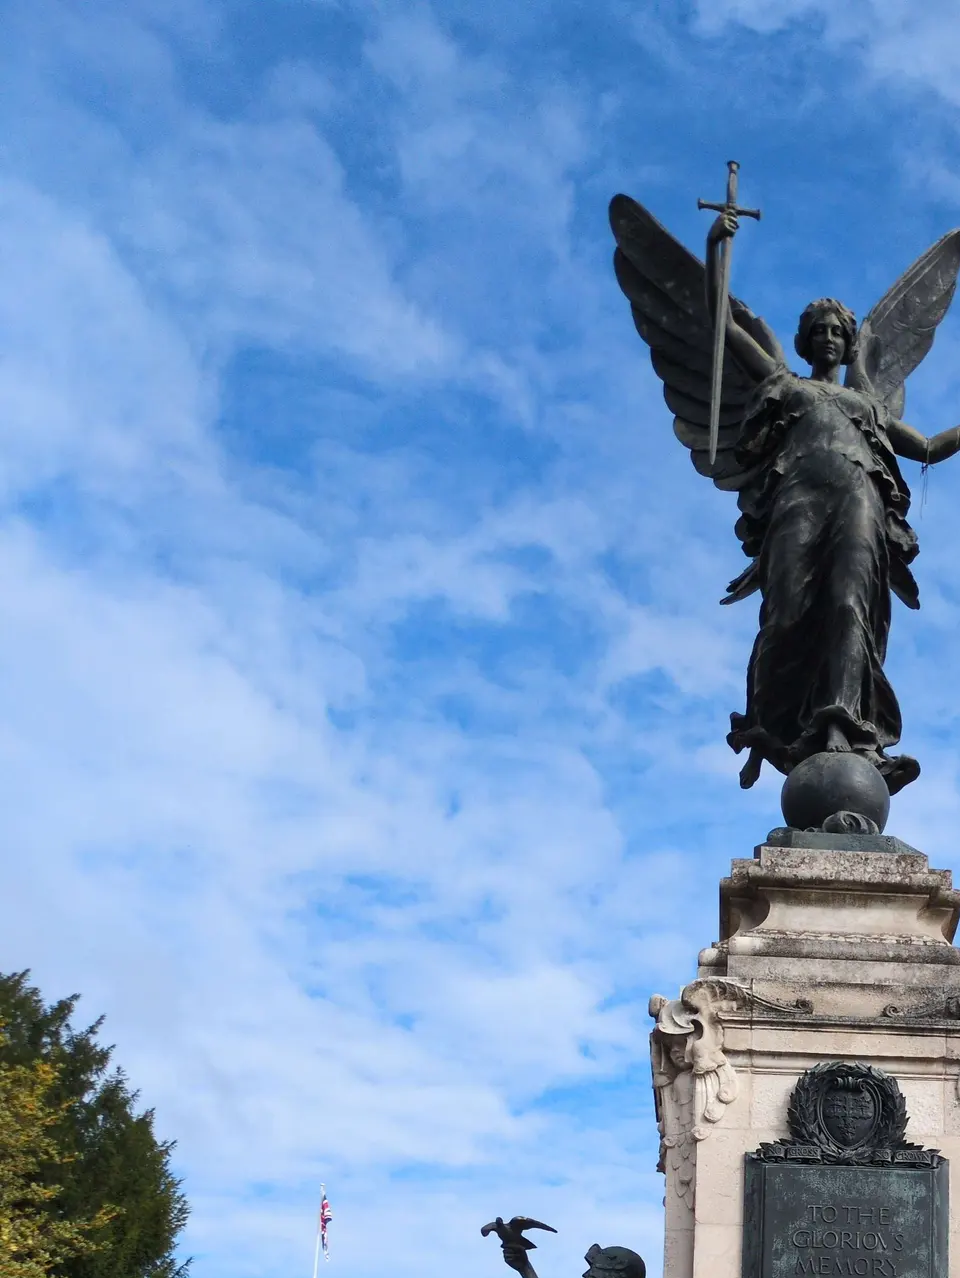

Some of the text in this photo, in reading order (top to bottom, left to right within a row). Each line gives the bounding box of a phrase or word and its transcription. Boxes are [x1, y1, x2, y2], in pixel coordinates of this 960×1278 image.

[768, 1146, 819, 1158] NO CROSS
[875, 1149, 889, 1160] NO
[807, 1204, 891, 1226] TO THE
[796, 1256, 902, 1277] MEMORY
